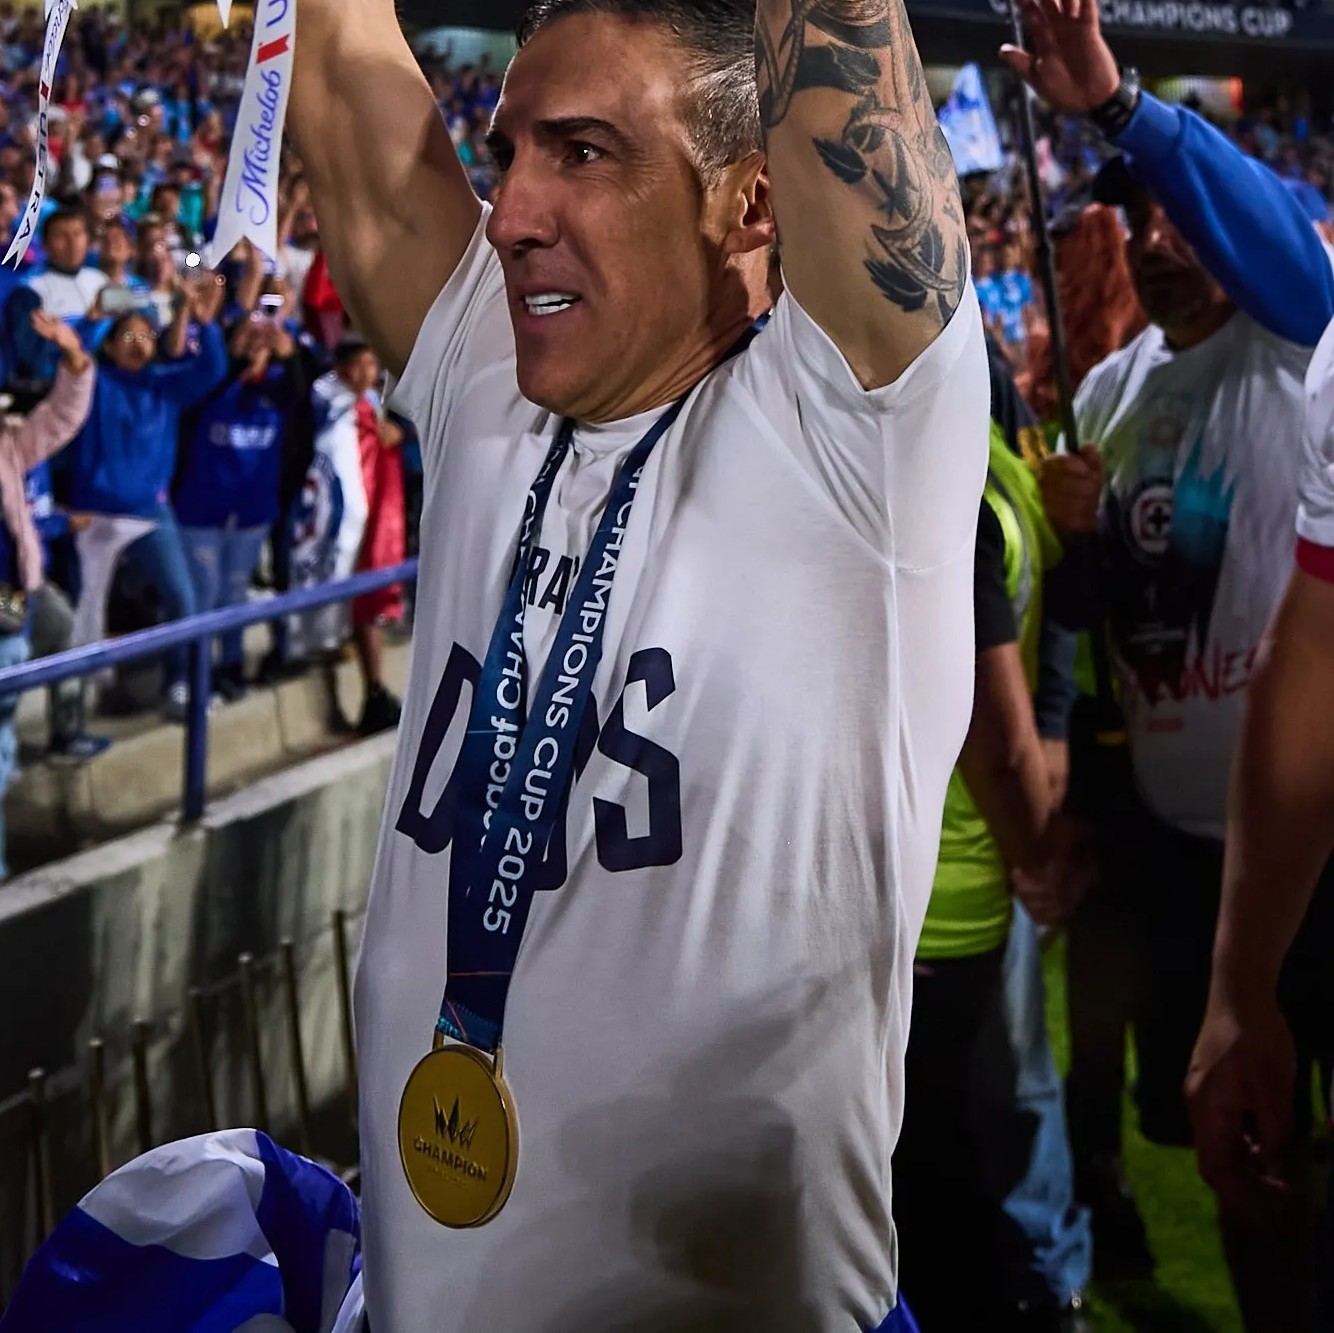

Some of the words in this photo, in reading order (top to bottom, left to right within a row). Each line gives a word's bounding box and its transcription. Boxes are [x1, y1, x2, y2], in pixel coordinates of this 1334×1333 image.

[1241, 5, 1292, 38] CUP
[236, 69, 281, 226] Michelob
[546, 501, 633, 729] CHAMPIONS
[520, 737, 559, 822] CUP
[482, 827, 533, 935] 2025
[413, 1134, 488, 1182] CHAMPION
